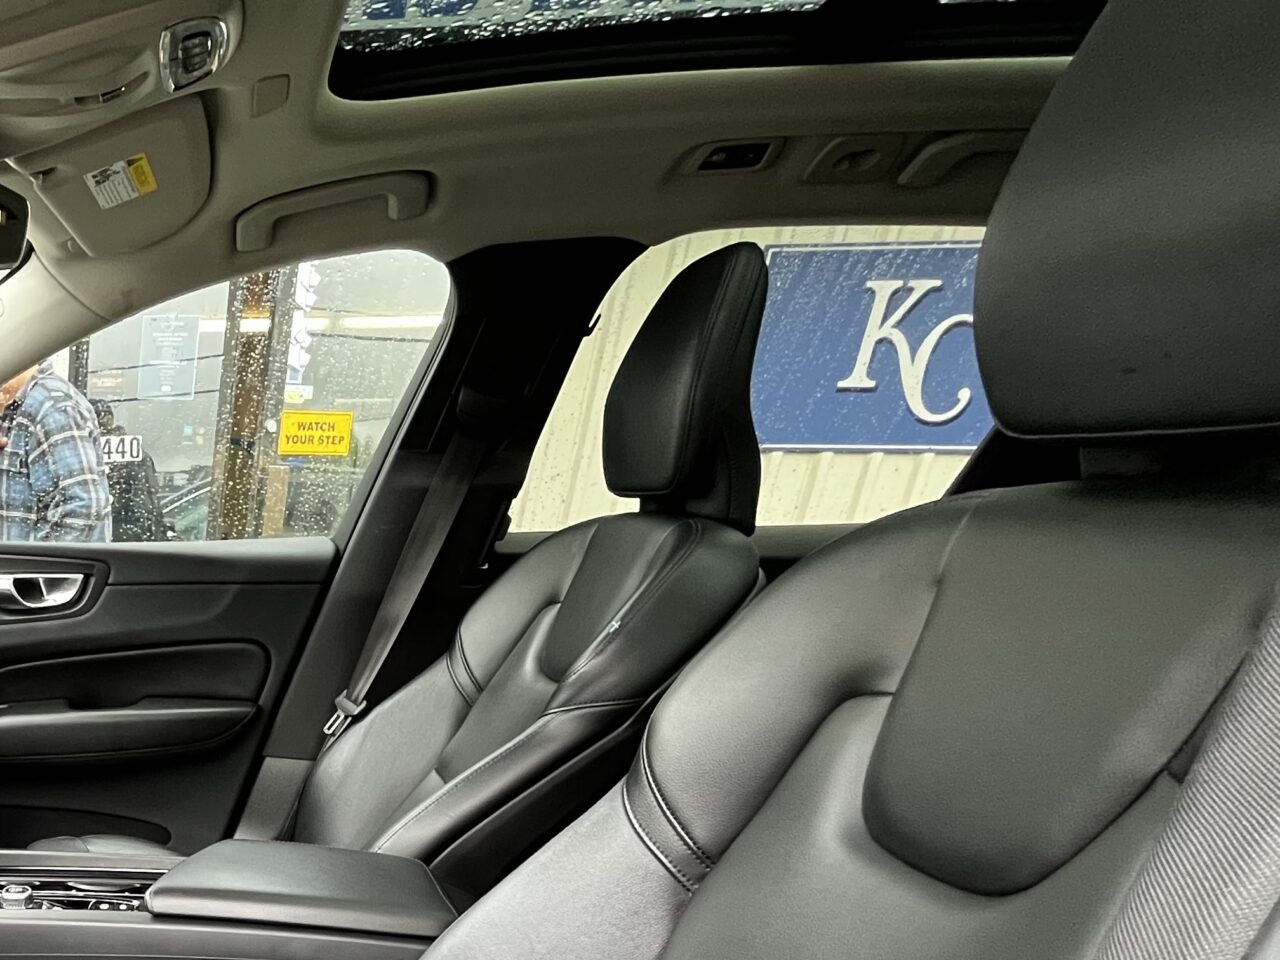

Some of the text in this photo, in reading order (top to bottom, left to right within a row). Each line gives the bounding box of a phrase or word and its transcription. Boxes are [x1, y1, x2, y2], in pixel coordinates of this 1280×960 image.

[296, 421, 336, 432] WATCH
[285, 433, 345, 446] YOUR STEP
